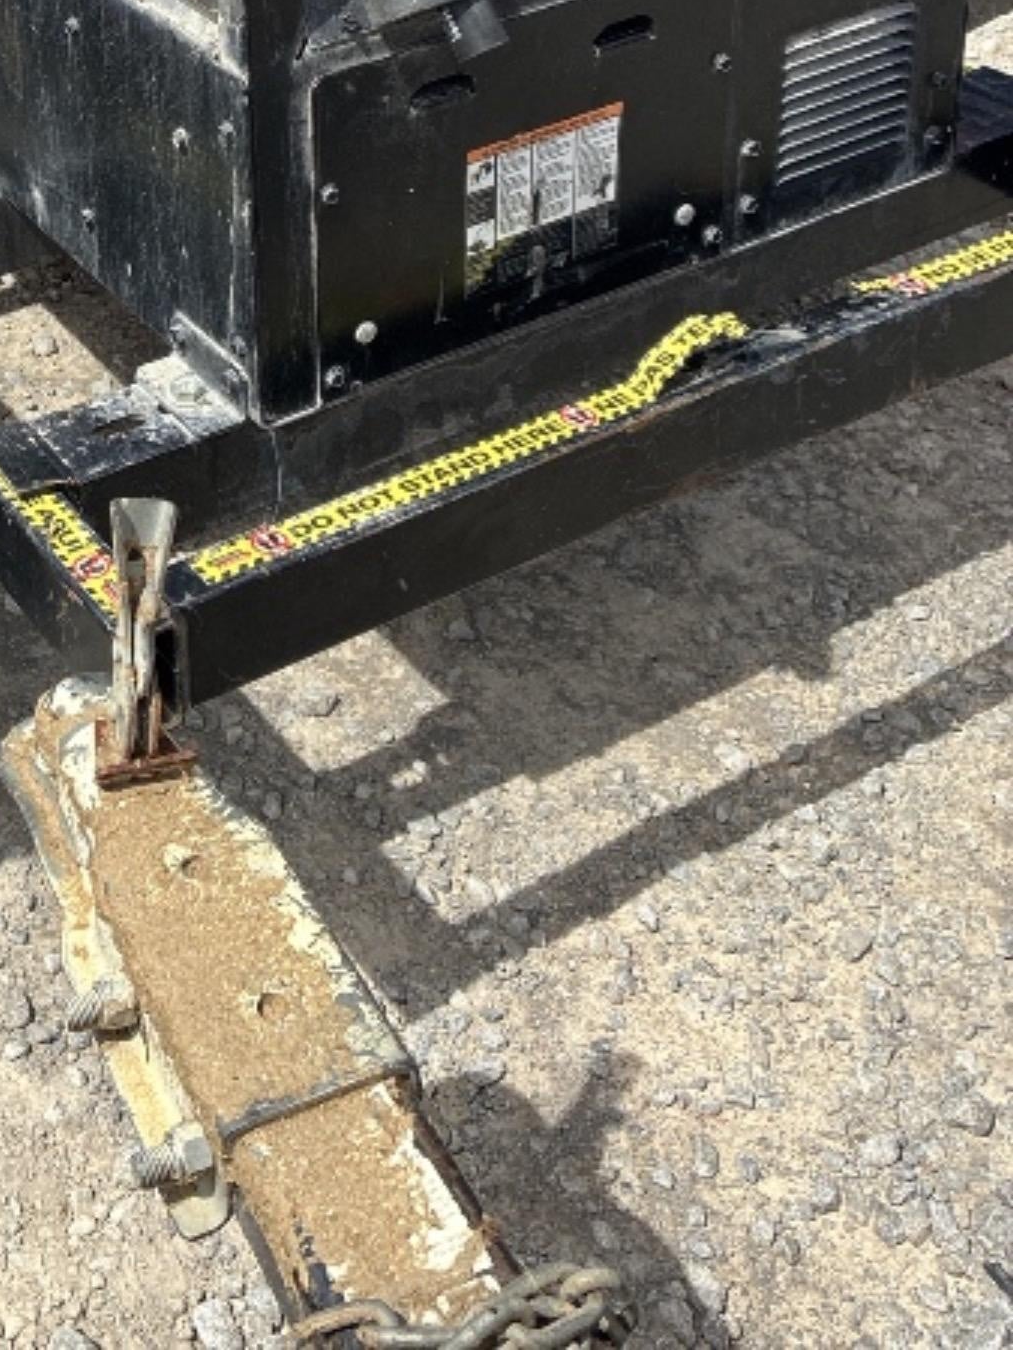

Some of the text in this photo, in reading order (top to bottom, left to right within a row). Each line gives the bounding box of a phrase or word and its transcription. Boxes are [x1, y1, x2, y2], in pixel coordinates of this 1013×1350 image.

[289, 418, 566, 539] DO NOT STAND HERE
